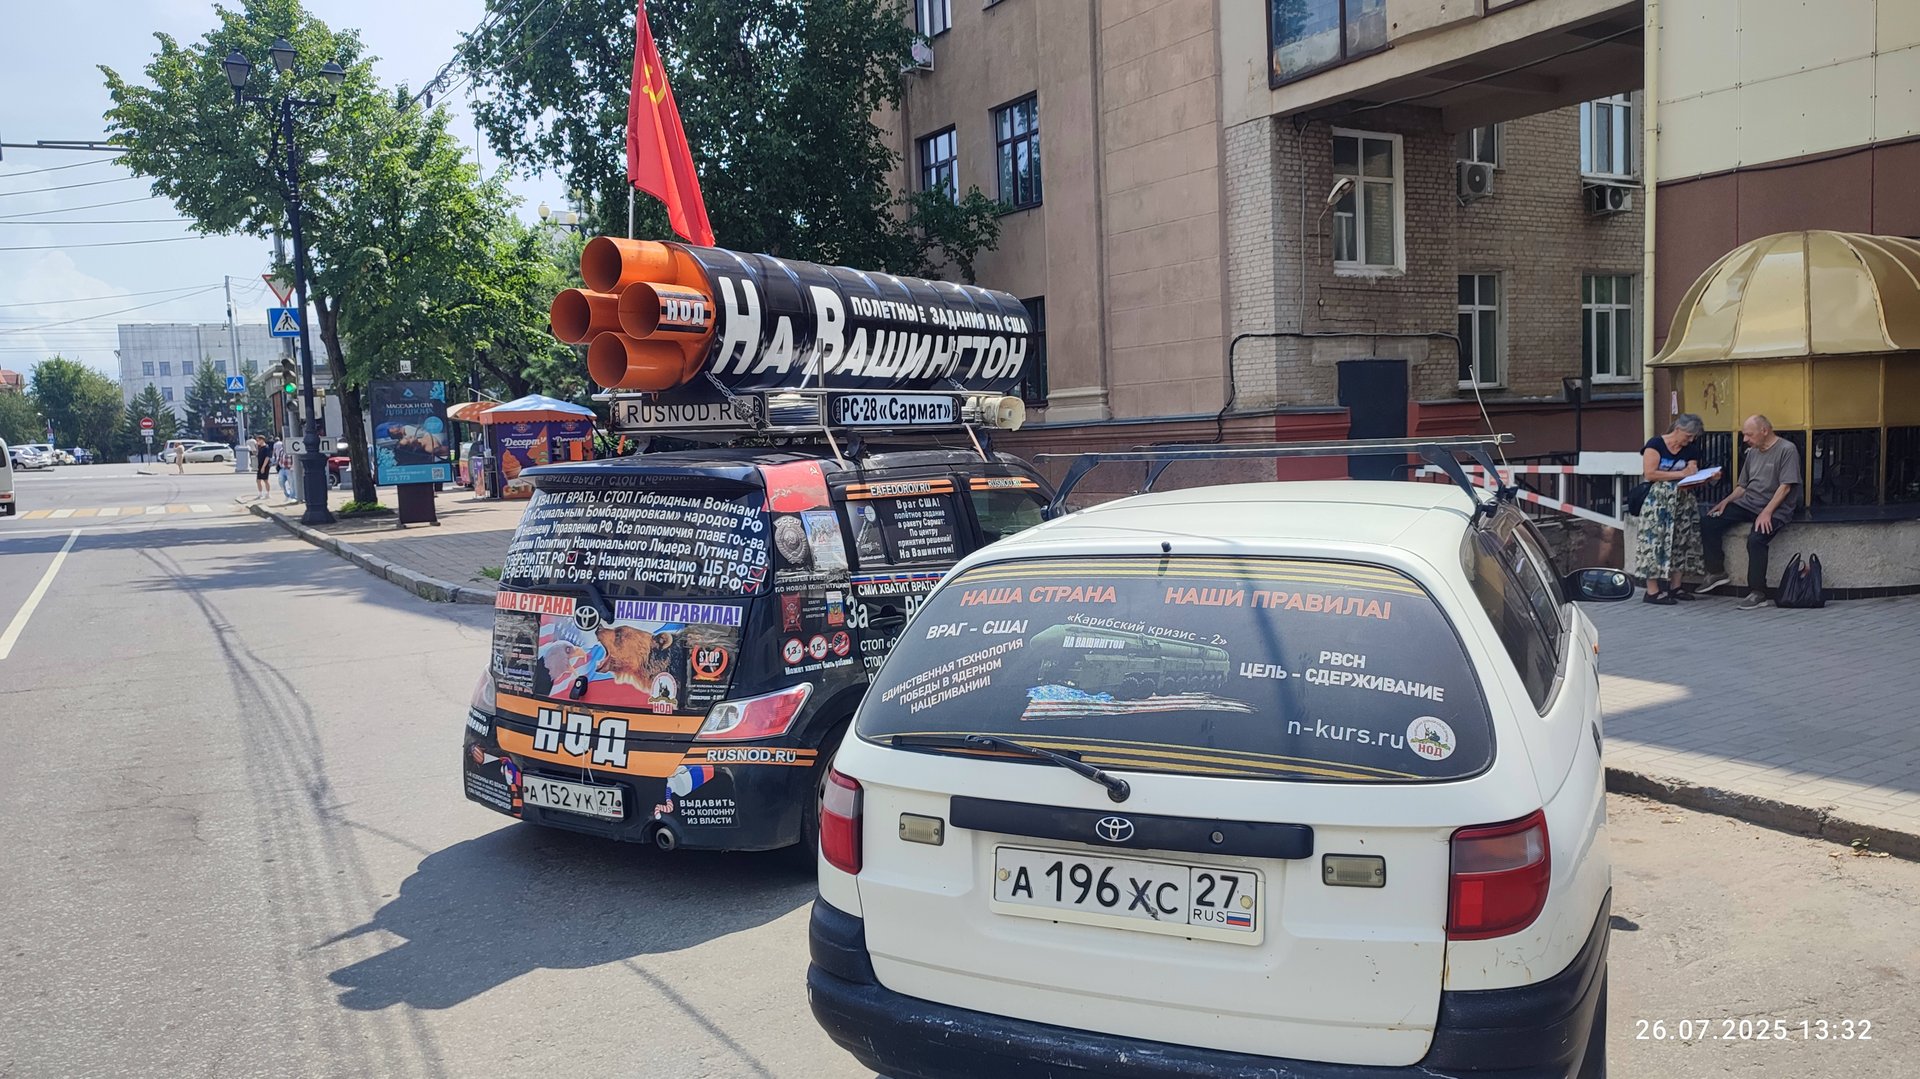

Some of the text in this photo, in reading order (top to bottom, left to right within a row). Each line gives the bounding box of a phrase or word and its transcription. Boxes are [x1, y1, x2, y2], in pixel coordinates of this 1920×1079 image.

[666, 299, 705, 326] НОД
[850, 296, 1029, 334] ПОЛЕТНЫЕ ЗАДАНИЯ НА США
[711, 276, 1027, 379] НА ВАШИНГТОН
[870, 482, 931, 497] EAFEDOROV.RU
[566, 491, 601, 504] ВРАТЬ!
[604, 490, 634, 504] СТОП
[634, 490, 701, 509] Гибридным
[703, 496, 761, 520] Войнам!
[896, 497, 941, 511] Враг США!
[922, 510, 945, 518] задание
[586, 504, 682, 522] Бомбардировкам»
[684, 511, 739, 529] народов
[741, 517, 764, 533] РФ
[902, 520, 923, 530] ракету
[551, 520, 598, 536] Управлению
[599, 519, 614, 534] РФ.
[616, 520, 633, 534] Все
[634, 524, 694, 539] полномочия
[909, 528, 938, 537] По центру
[534, 535, 572, 551] Политику
[572, 535, 648, 552] Национального
[648, 538, 692, 557] Лидера
[694, 541, 740, 561] Путина
[742, 547, 769, 567] В.В.
[899, 544, 954, 559] На Вашингтон!
[551, 551, 566, 565] РФ
[584, 551, 597, 566] За
[597, 552, 697, 573] Национализацию
[703, 559, 724, 577] ЦБ
[726, 561, 749, 578] РФ
[553, 570, 566, 579] по
[719, 575, 742, 591] РФ
[786, 584, 808, 592] НОВОЙ
[857, 585, 878, 596] СМИ
[879, 583, 910, 595] ХВАТИТ
[519, 593, 574, 615] СТРАНА
[959, 585, 1117, 606] НАША СТРАНА
[1164, 586, 1392, 620] НАШИ ПРАВИЛА!
[616, 601, 741, 626] НАШИ ПРАВИЛА!
[845, 596, 869, 629] За
[926, 622, 968, 640] ВРАГ
[982, 619, 1029, 635] США!
[1067, 612, 1146, 632] «Карибский
[1148, 625, 1197, 641] кризис
[1211, 634, 1228, 646] 2»
[860, 638, 885, 651] СТОП
[1062, 635, 1075, 648] НА
[699, 651, 720, 662] STOP
[1318, 650, 1367, 669] РВСН
[785, 666, 804, 675] Может
[805, 663, 822, 672] хватит
[822, 660, 835, 668] быть
[881, 638, 1024, 703] ЕДИНСТВЕННАЯ ТЕХНОЛОГИЯ
[899, 657, 1003, 706] ПОБЕДЫ В ЯДЕРНОМ
[1239, 662, 1288, 681] ЦЕЛЬ
[1305, 667, 1446, 703] СДЕРЖИВАНИЕ
[910, 675, 992, 714] НАЦЕЛИВАНИИ!
[654, 703, 673, 714] НОД
[534, 708, 630, 768] НОД
[1287, 718, 1404, 750] n-kurs.ru
[706, 749, 797, 763] RUSNOD.RU
[1418, 743, 1443, 758] НОД
[597, 790, 616, 807] 27
[679, 799, 735, 808] ВЫДАВИТЬ
[599, 806, 612, 814] RUS
[680, 808, 736, 816] 5-Ю КОЛОННУ
[687, 817, 732, 825] ИЗ ВЛАСТИ
[1196, 873, 1239, 909] 27
[1193, 908, 1226, 923] RUS
